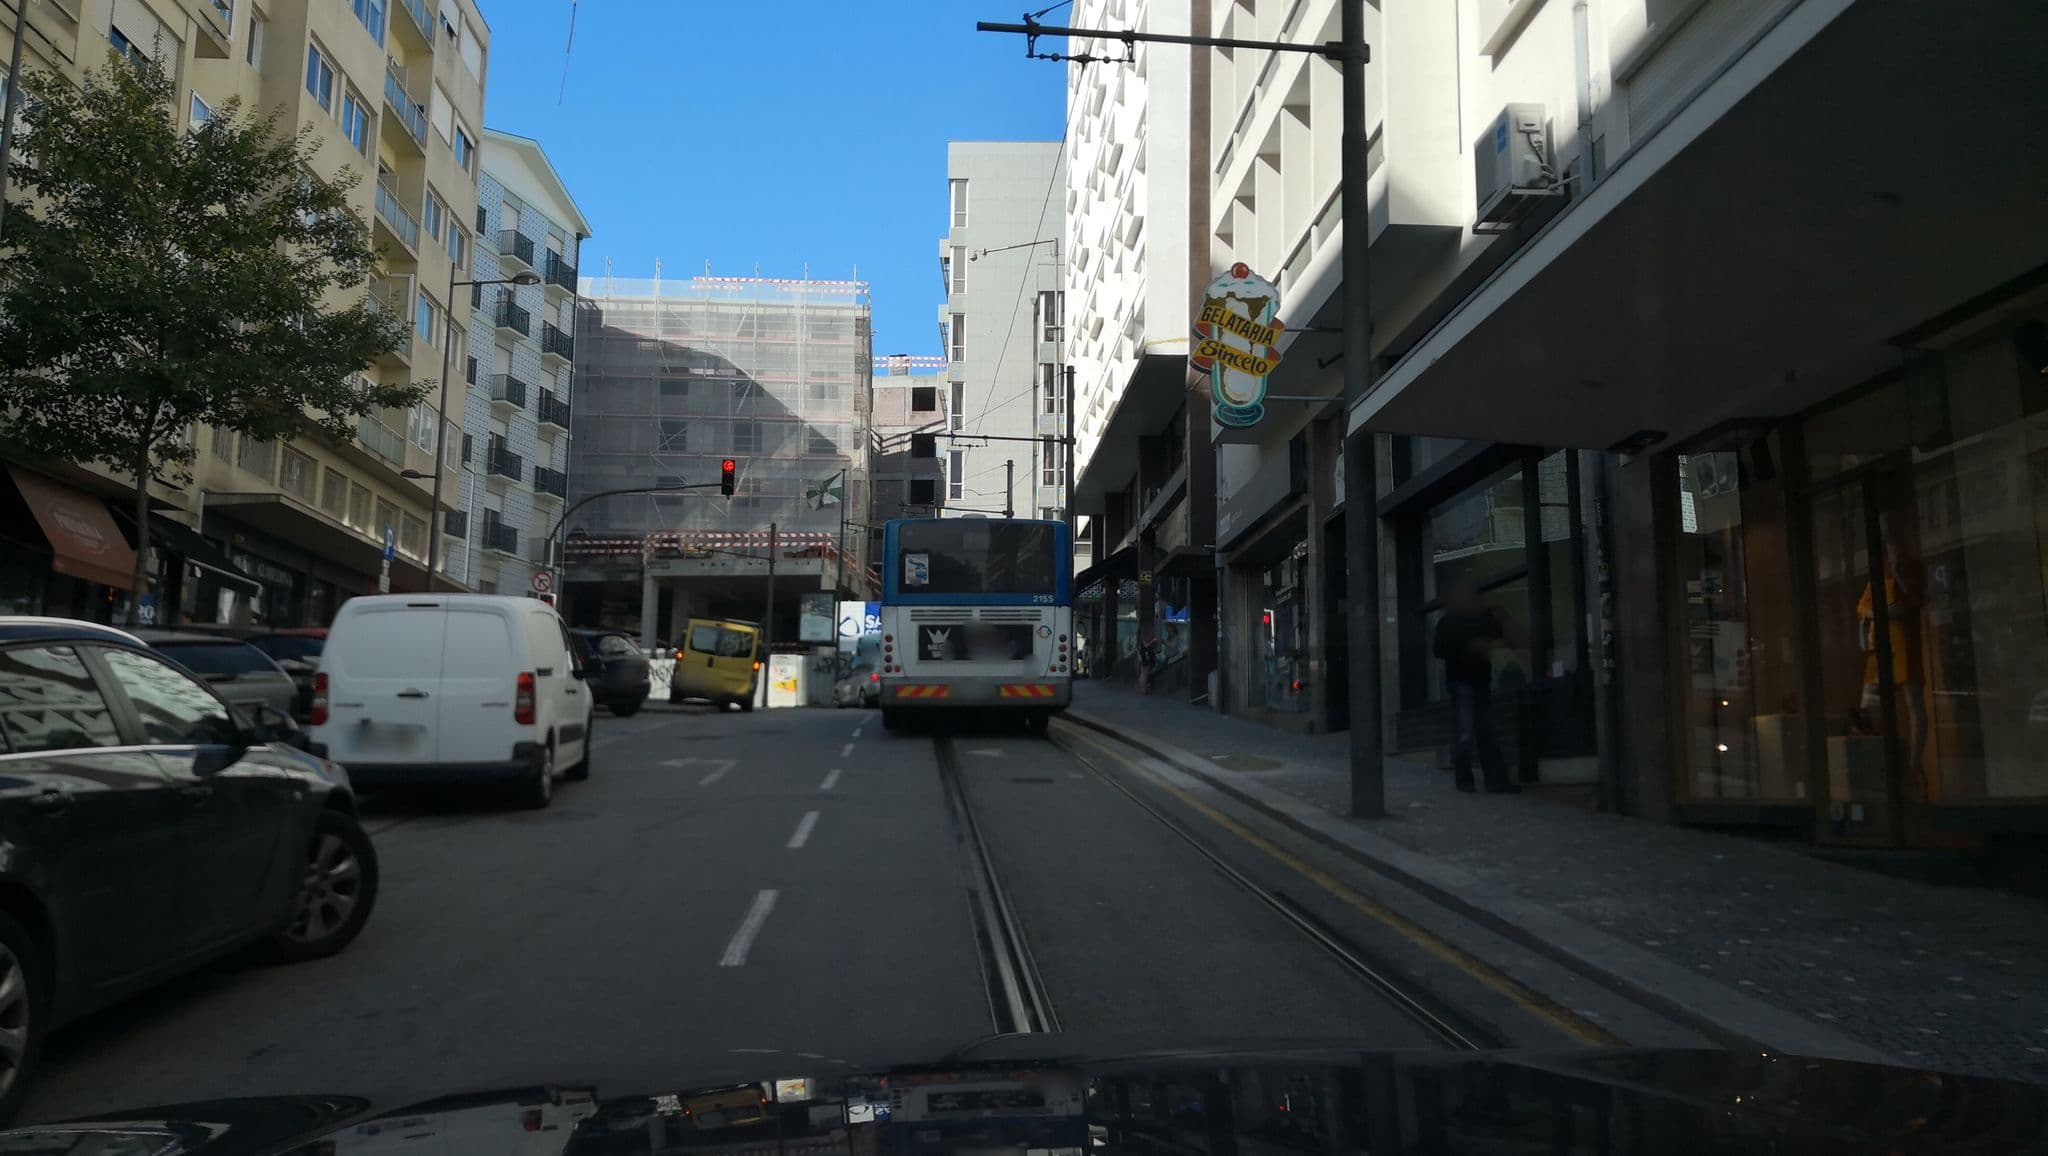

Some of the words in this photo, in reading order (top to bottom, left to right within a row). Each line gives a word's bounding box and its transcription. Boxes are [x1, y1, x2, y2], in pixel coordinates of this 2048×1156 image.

[1200, 306, 1275, 346] GELATARIA
[1200, 340, 1268, 374] Sincelo
[1032, 594, 1054, 603] 2155
